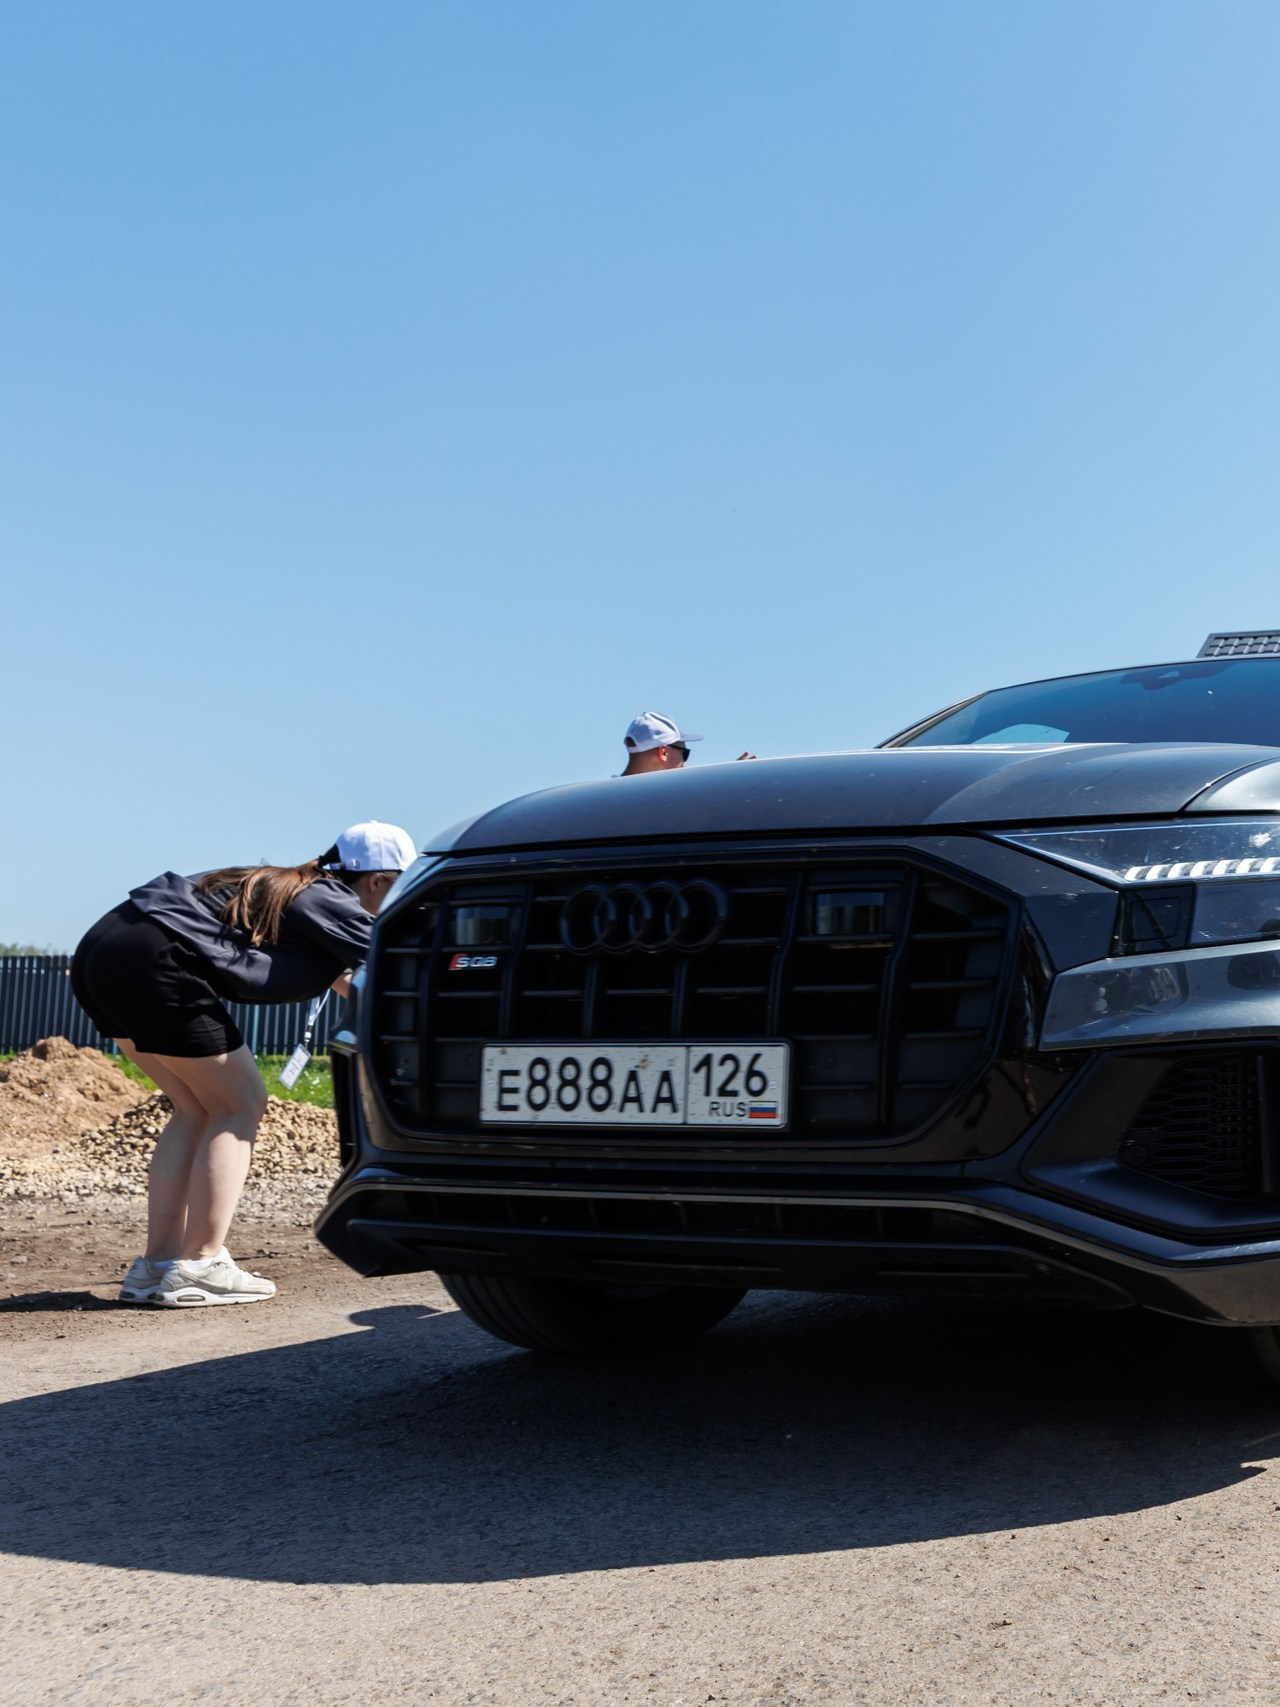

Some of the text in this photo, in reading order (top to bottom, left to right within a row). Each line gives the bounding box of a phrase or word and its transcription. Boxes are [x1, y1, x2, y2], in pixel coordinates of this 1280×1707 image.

[455, 956, 498, 968] SQ8
[497, 1053, 768, 1114] Е888АА 126
[708, 1101, 747, 1118] RUS
